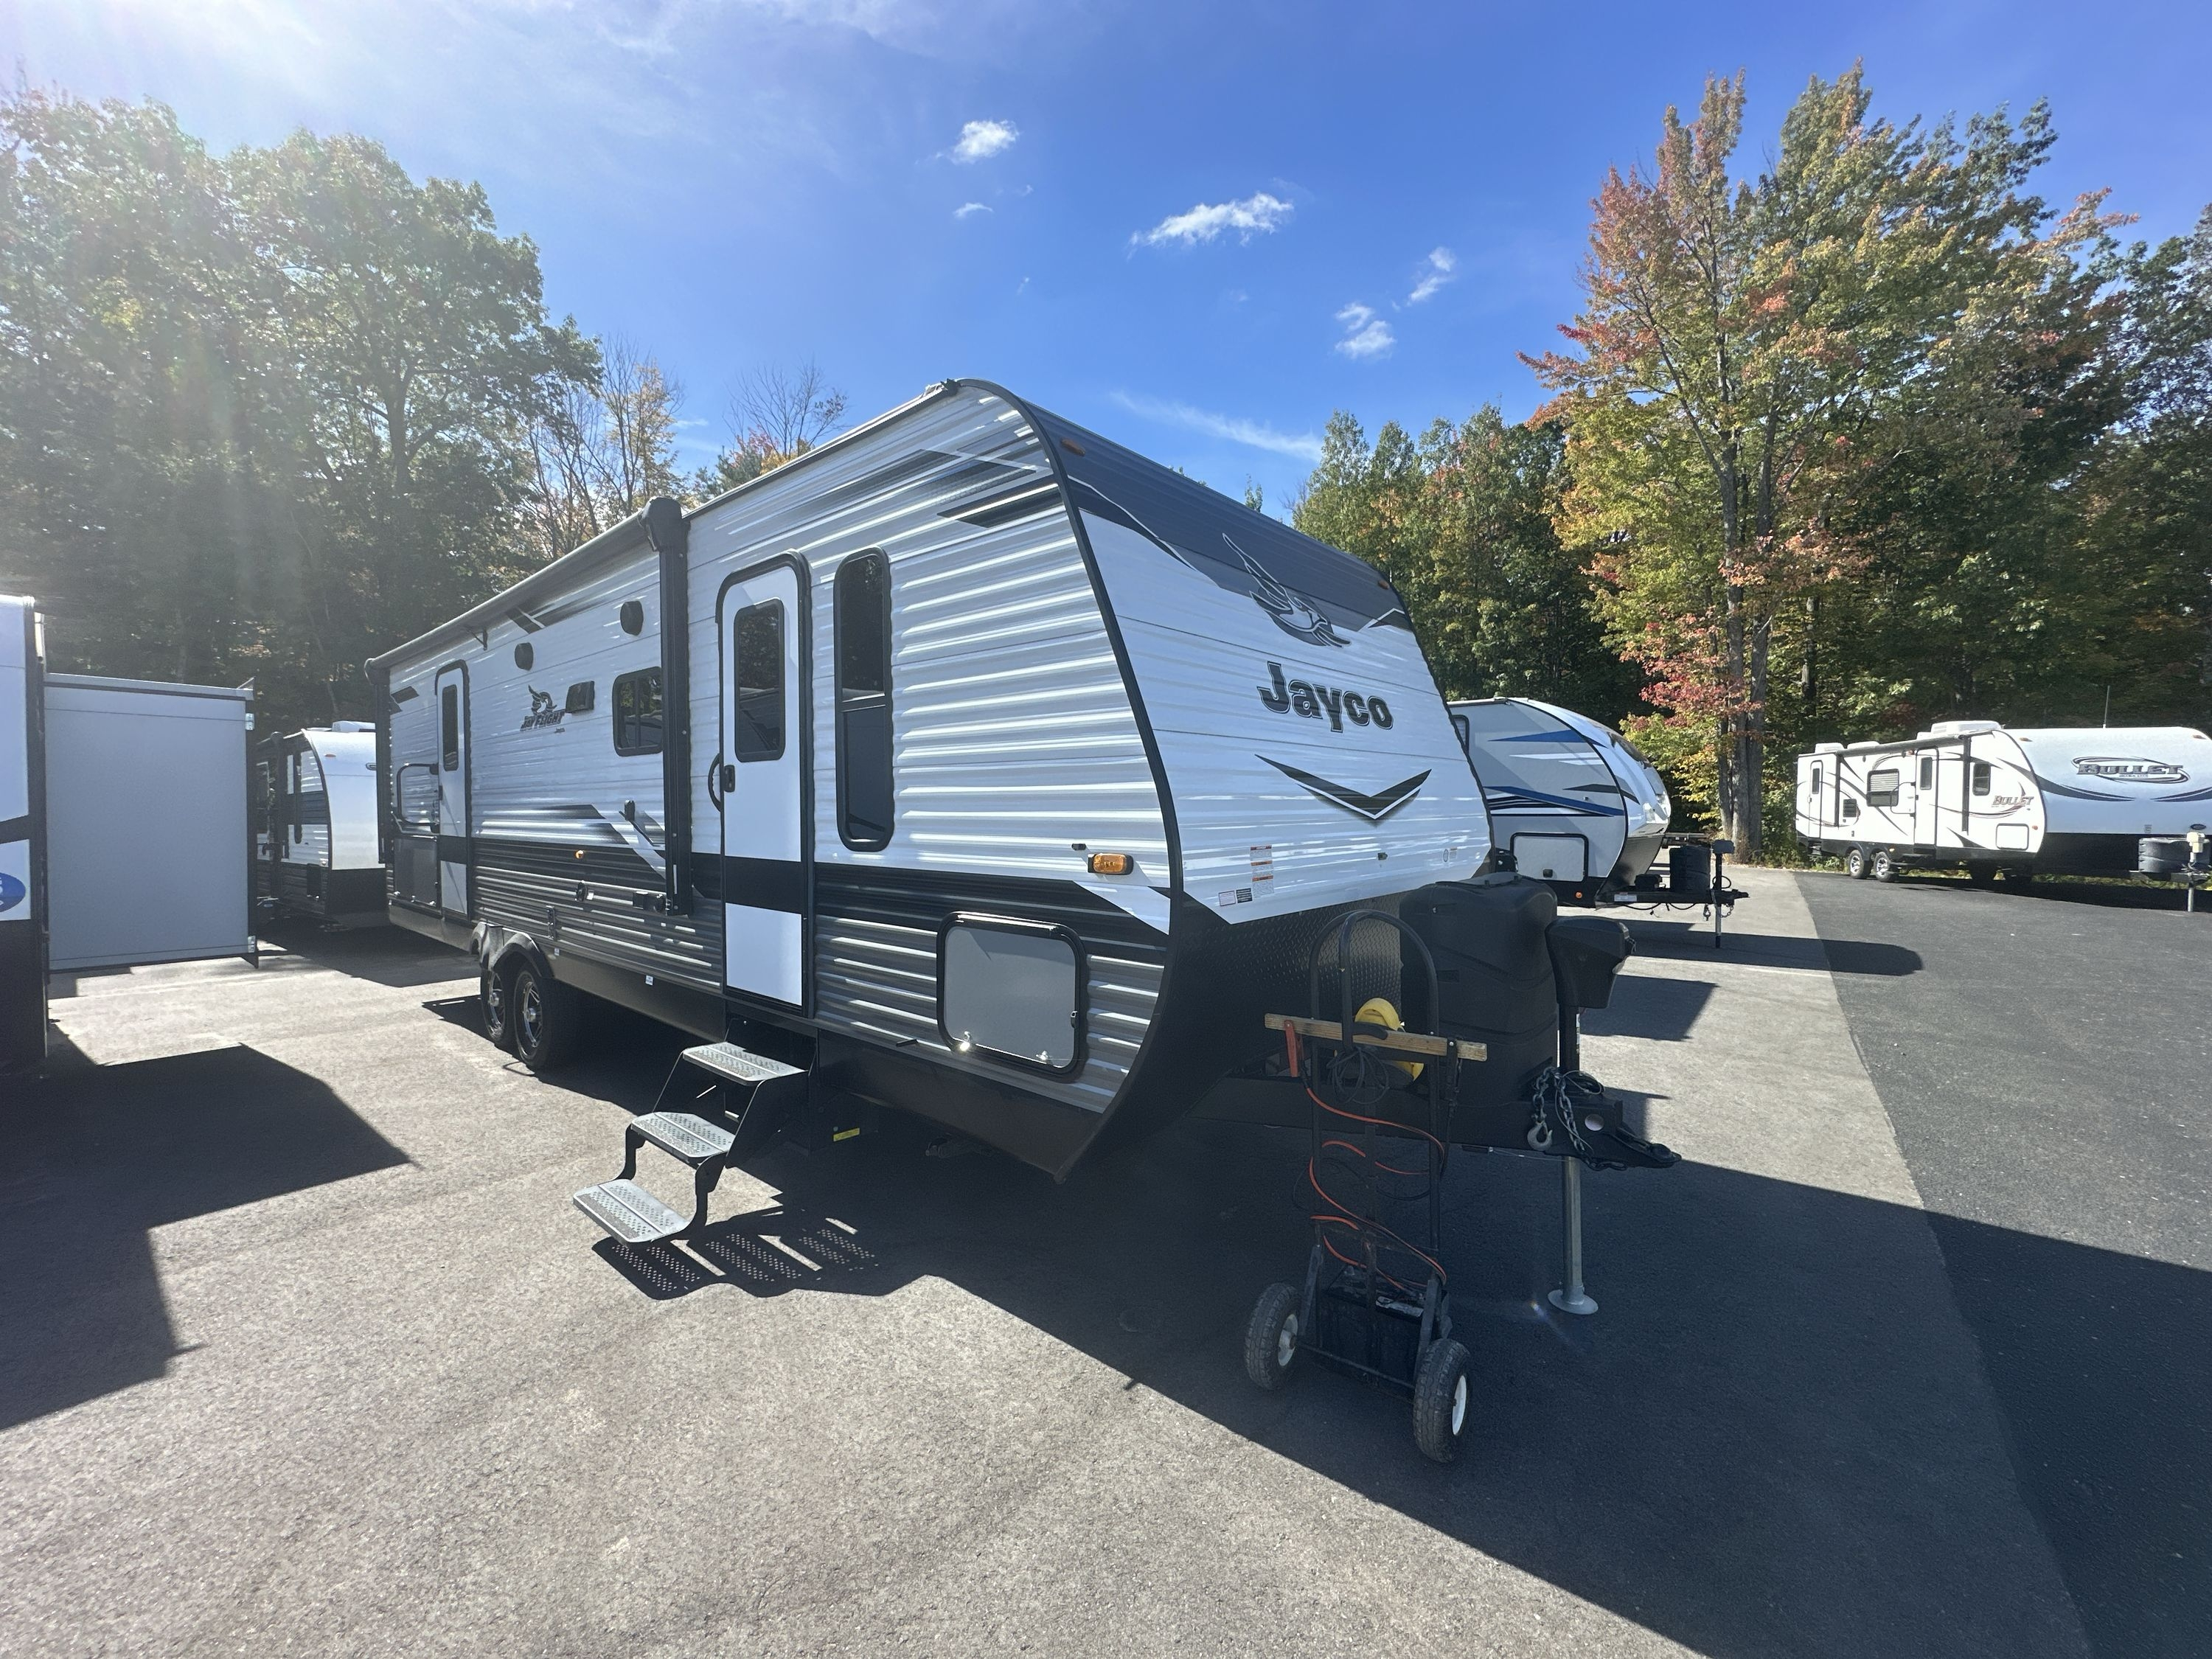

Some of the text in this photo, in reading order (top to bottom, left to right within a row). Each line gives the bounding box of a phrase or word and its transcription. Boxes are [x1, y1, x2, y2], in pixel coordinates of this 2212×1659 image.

[1256, 661, 1394, 733] Jayco
[535, 709, 566, 728] FLIGHT
[2076, 764, 2183, 775] BULLET
[1992, 796, 2034, 805] BULLET
